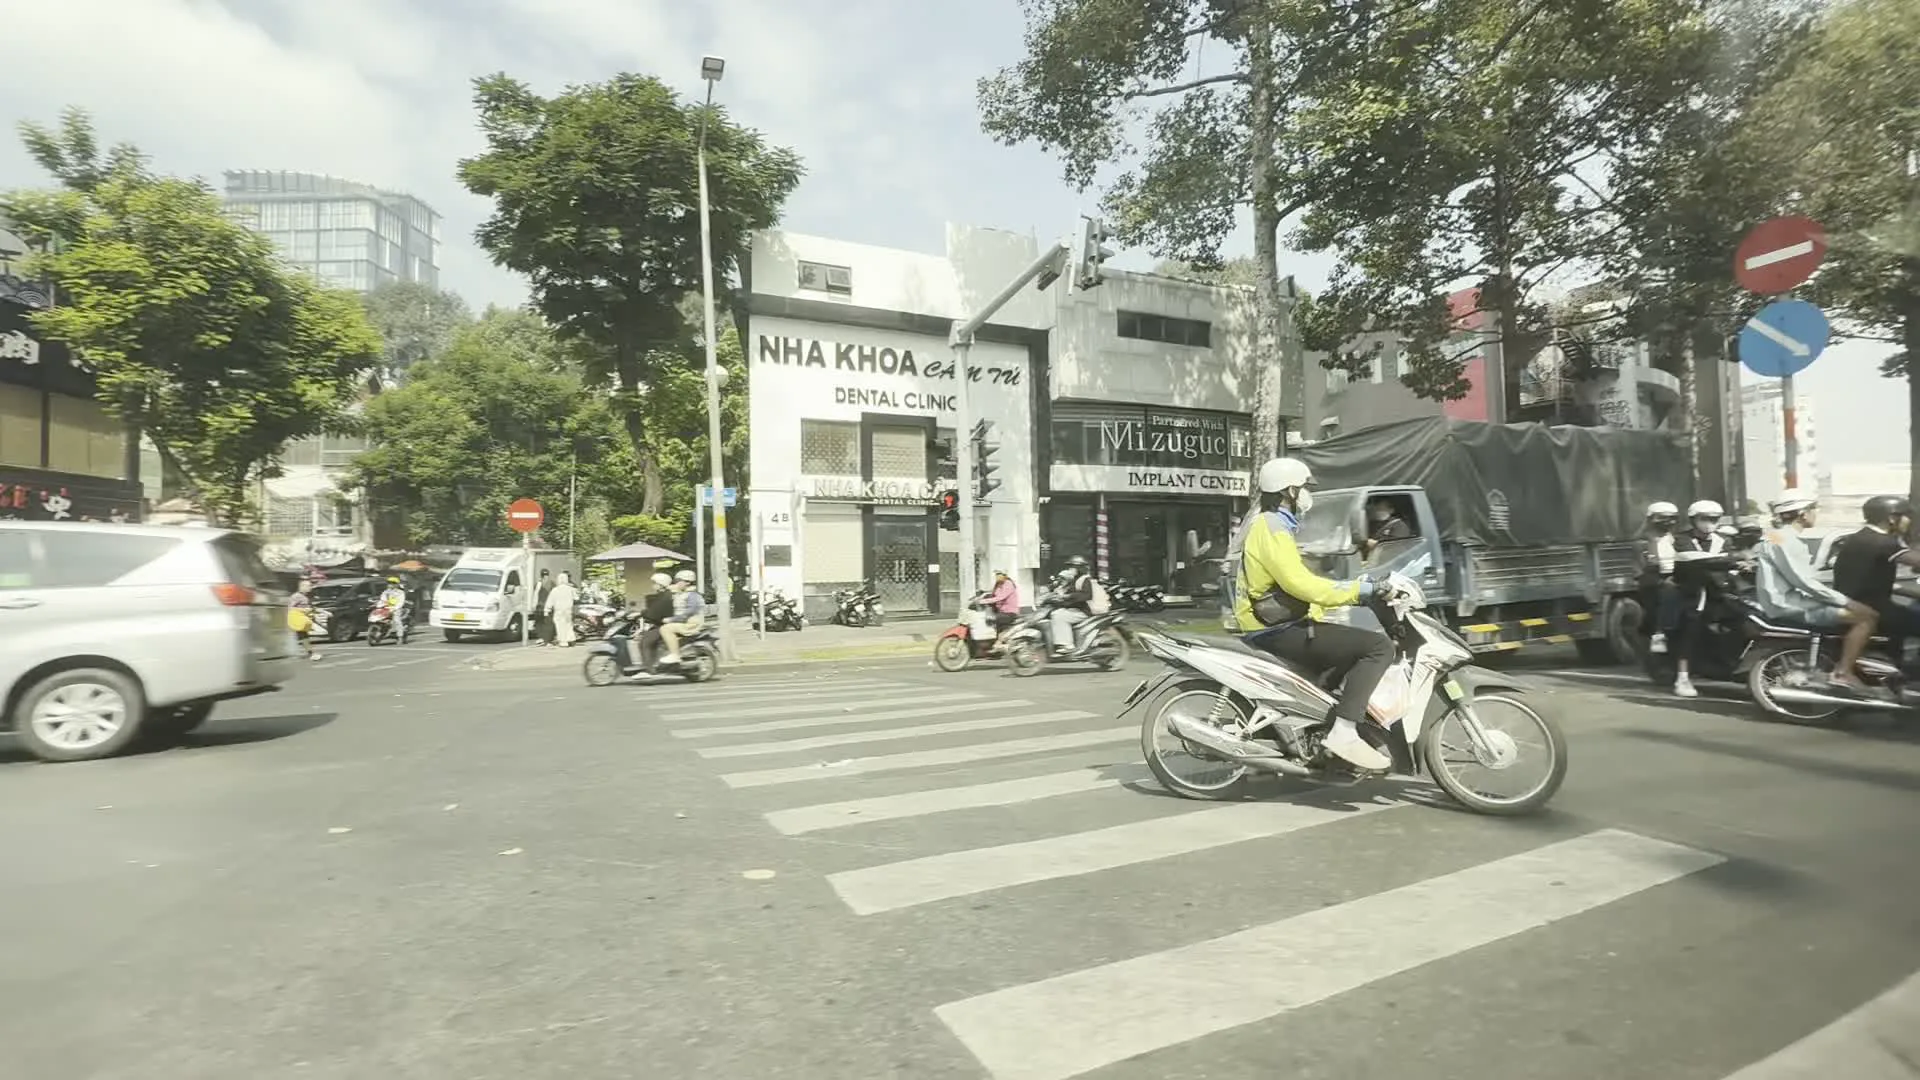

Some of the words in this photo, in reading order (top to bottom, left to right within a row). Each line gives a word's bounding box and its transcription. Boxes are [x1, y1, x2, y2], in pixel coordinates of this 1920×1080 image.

[759, 335, 826, 368] NHA
[835, 342, 918, 377] KHOA
[835, 386, 899, 408] DENTAL
[814, 478, 853, 497] NHA
[861, 480, 914, 499] KHOA
[1128, 472, 1196, 488] IMPLANT
[1200, 475, 1246, 491] CENTER
